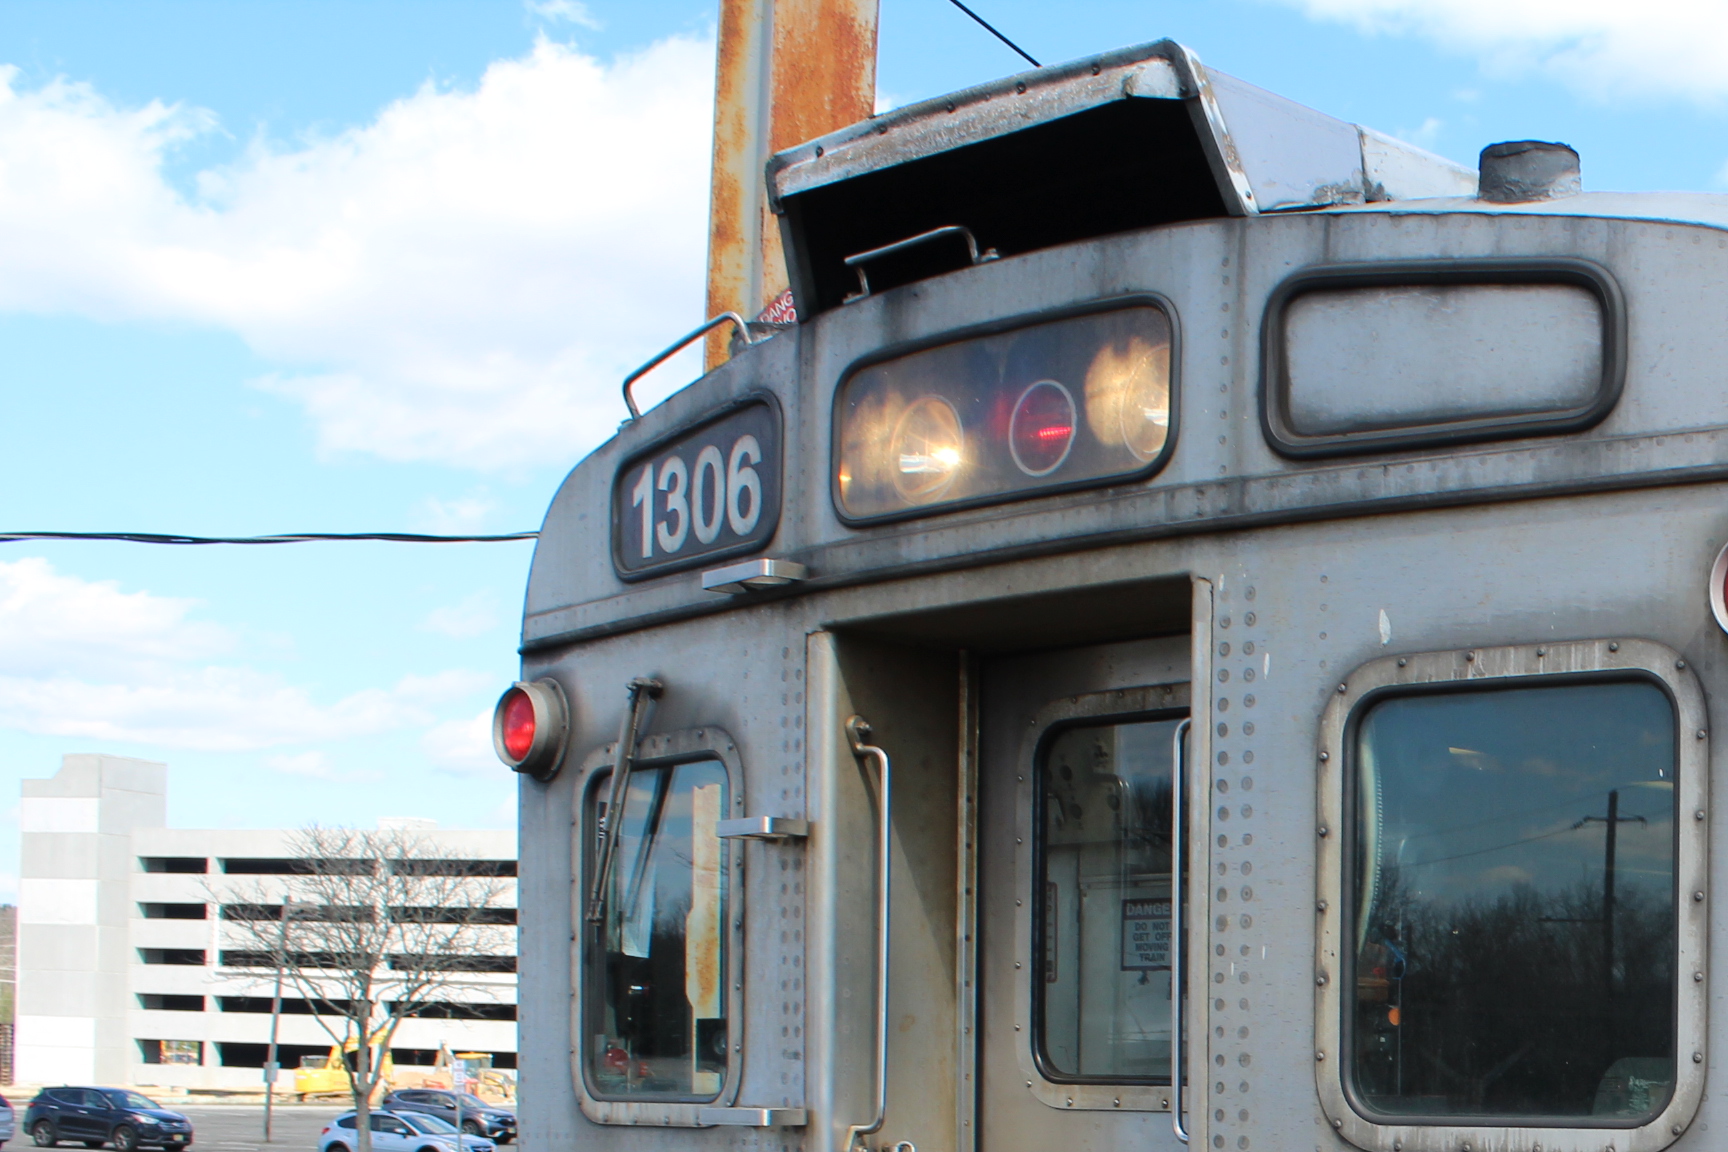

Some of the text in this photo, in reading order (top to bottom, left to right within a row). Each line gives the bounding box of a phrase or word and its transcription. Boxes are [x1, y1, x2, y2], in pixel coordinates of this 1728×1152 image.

[633, 434, 762, 558] 1306
[1134, 922, 1148, 931] DO
[1132, 932, 1150, 942] GET
[1135, 942, 1169, 952] MOVING
[1139, 952, 1166, 962] TRAIN
